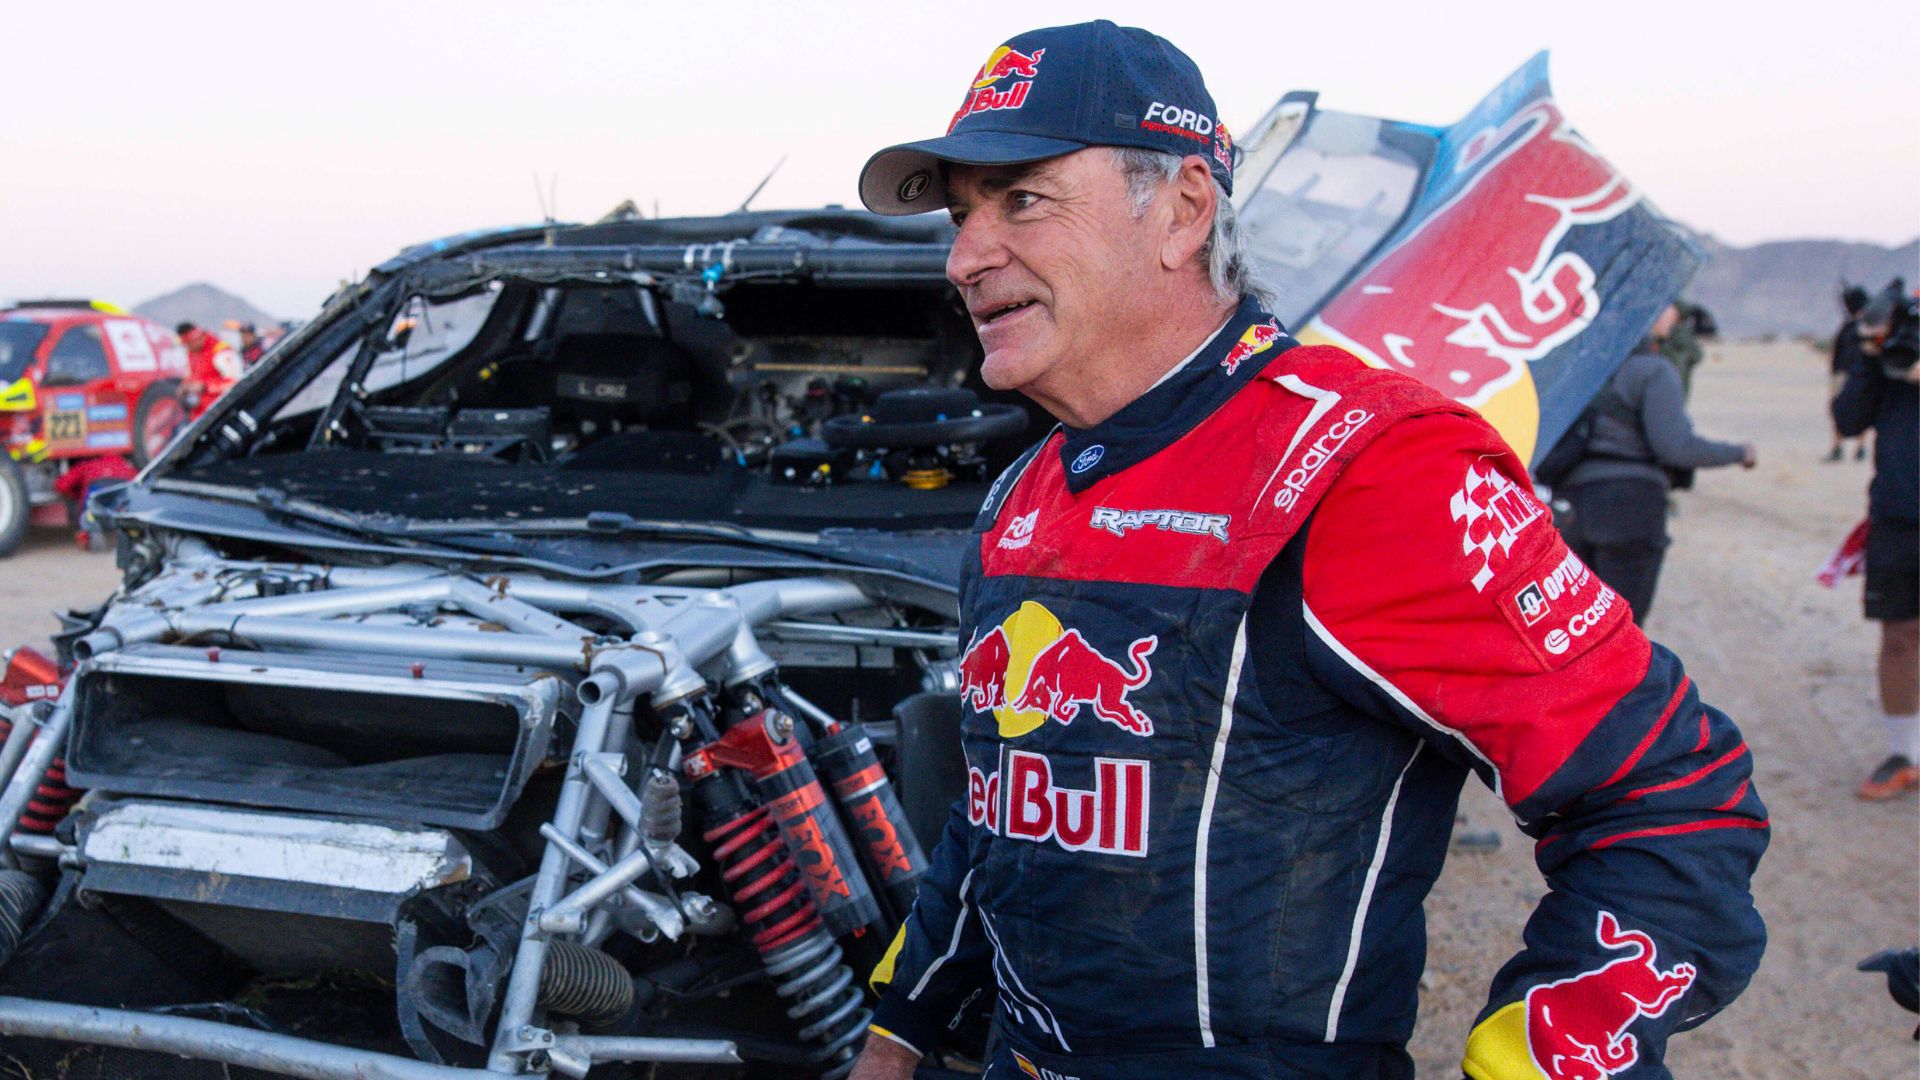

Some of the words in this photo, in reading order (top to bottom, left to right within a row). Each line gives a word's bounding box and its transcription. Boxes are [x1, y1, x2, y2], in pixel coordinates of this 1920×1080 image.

[972, 80, 1033, 113] Bull
[1144, 101, 1213, 135] FORD
[1274, 409, 1375, 513] sparco
[1089, 506, 1231, 544] RAPTOR
[850, 795, 912, 880] FOX
[967, 748, 1001, 836] ed
[1006, 750, 1150, 858] Bull
[786, 815, 851, 907] FOX
